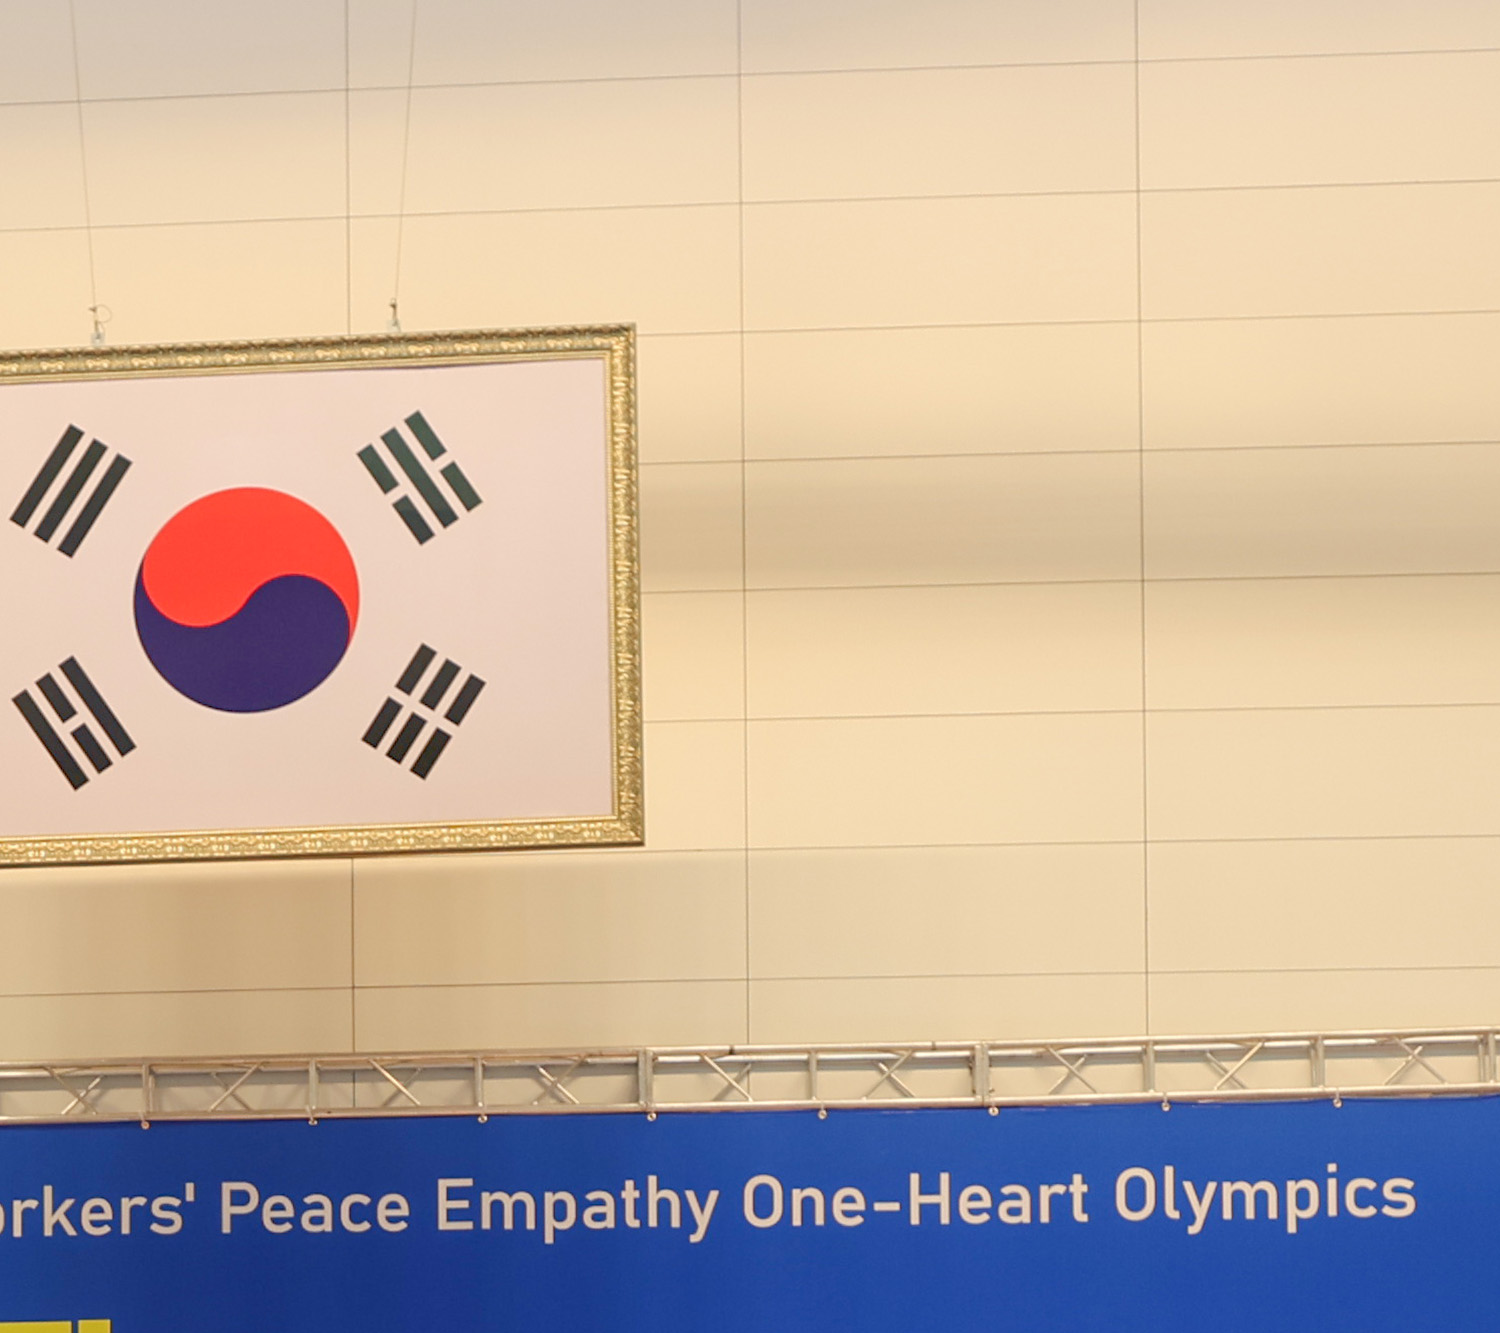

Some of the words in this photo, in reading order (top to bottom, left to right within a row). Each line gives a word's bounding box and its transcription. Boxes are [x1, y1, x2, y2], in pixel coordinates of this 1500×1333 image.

[220, 1180, 408, 1235] Peace
[435, 1175, 719, 1245] Empathy
[742, 1171, 1089, 1229] One-Heart
[1113, 1164, 1417, 1235] Olympics
